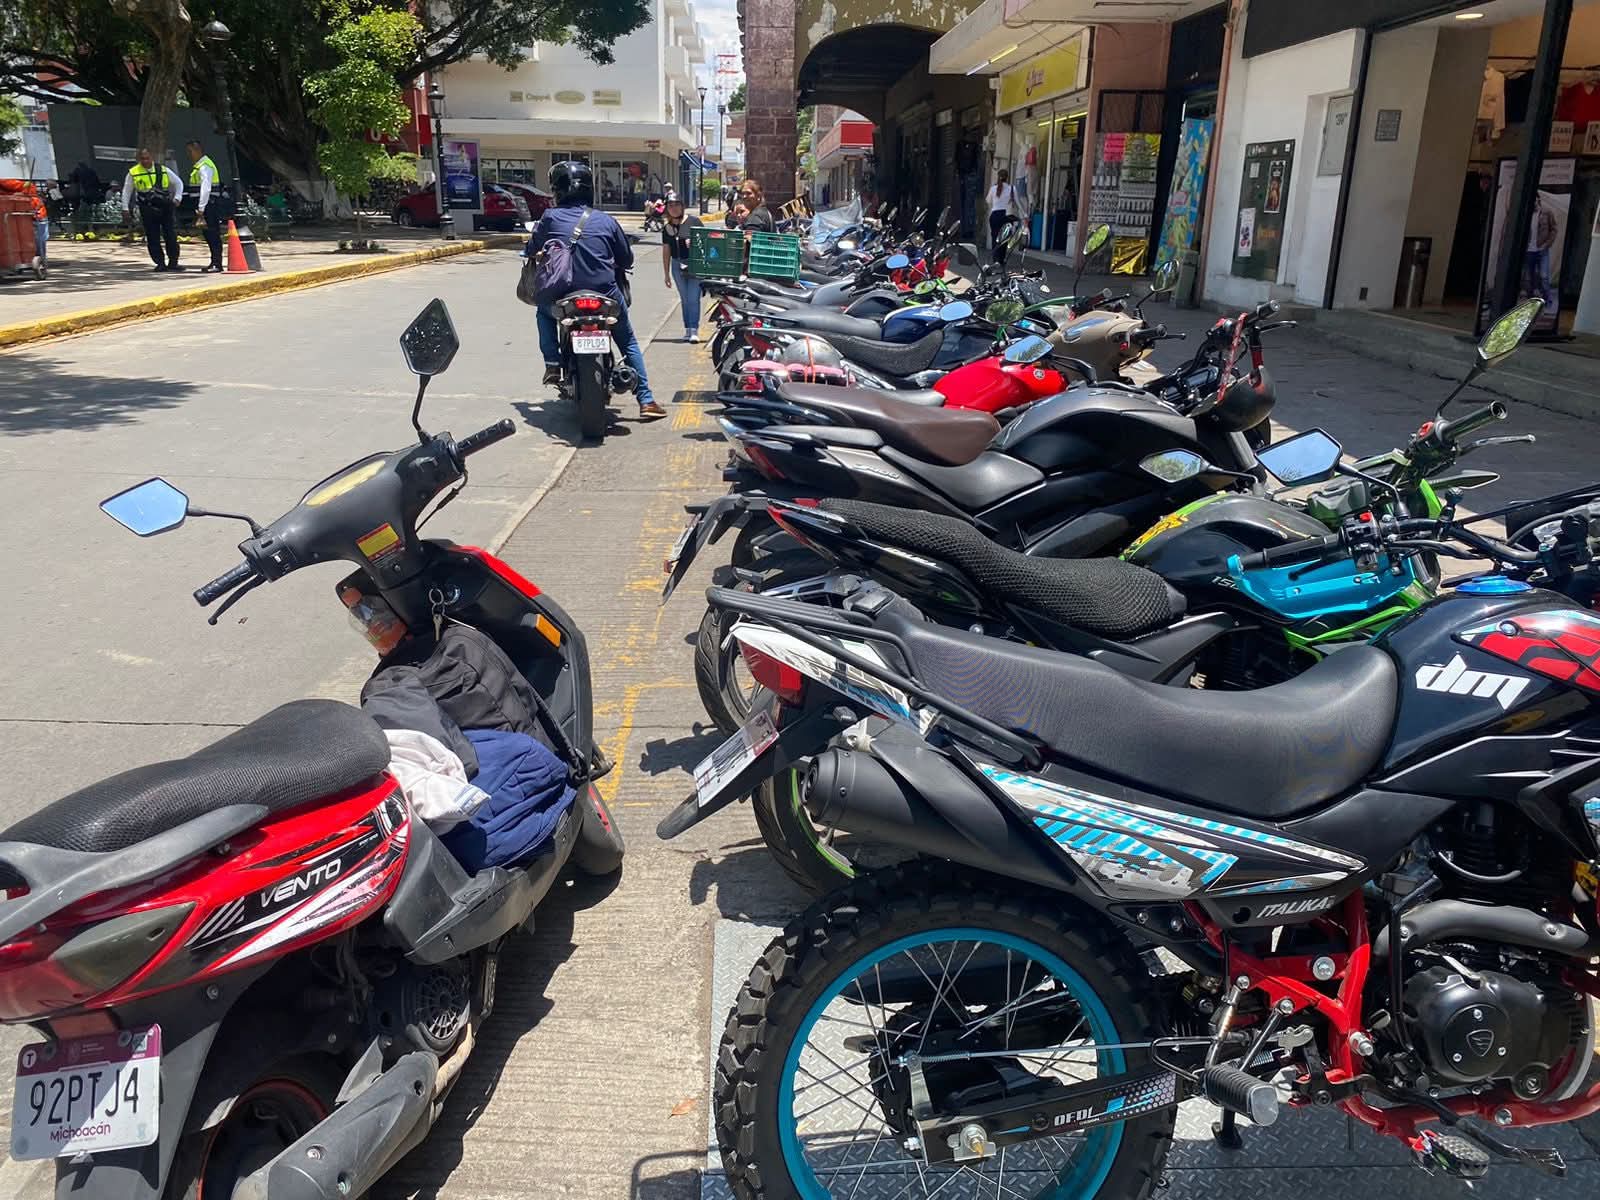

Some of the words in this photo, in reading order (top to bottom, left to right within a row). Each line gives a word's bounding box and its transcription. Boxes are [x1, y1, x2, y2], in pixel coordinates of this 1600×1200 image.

[259, 857, 342, 909] VENTO
[1256, 896, 1329, 919] ITALIKA
[29, 1066, 140, 1127] 92PTJ4
[49, 1121, 112, 1143] Michoacán
